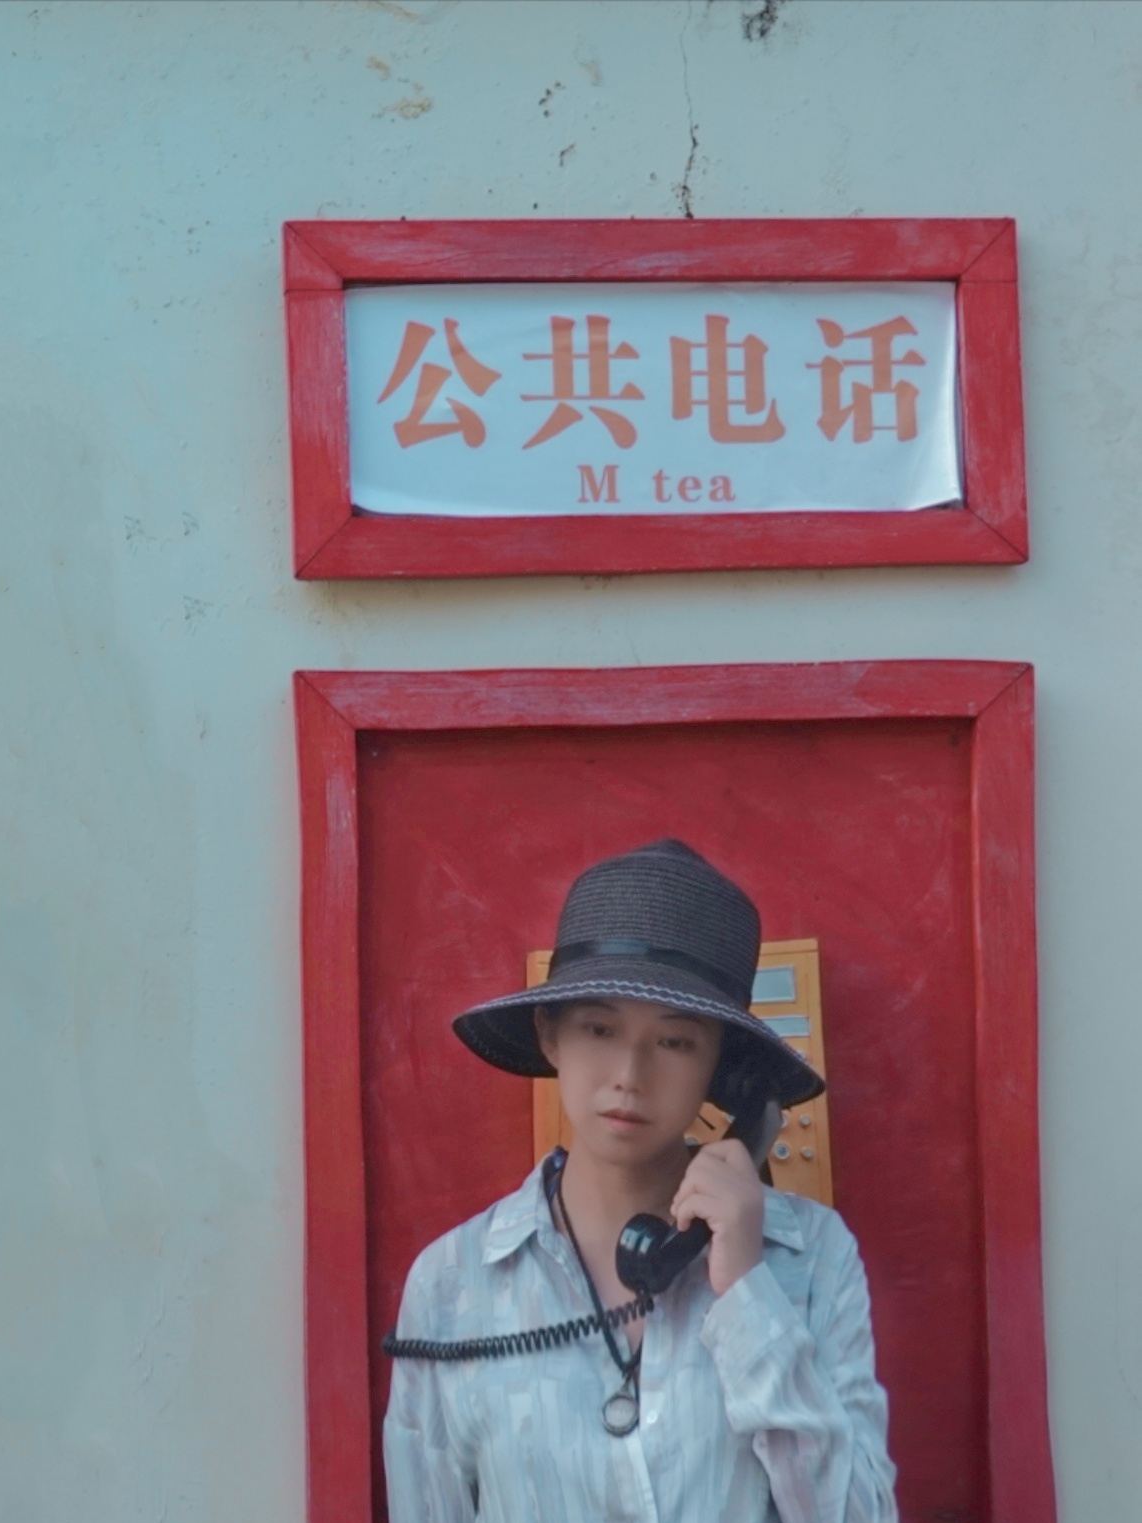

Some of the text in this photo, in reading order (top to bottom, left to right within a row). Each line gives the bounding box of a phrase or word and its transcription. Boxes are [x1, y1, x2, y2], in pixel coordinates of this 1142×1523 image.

[376, 314, 927, 450] 公共电话
[576, 464, 737, 505] M tea
